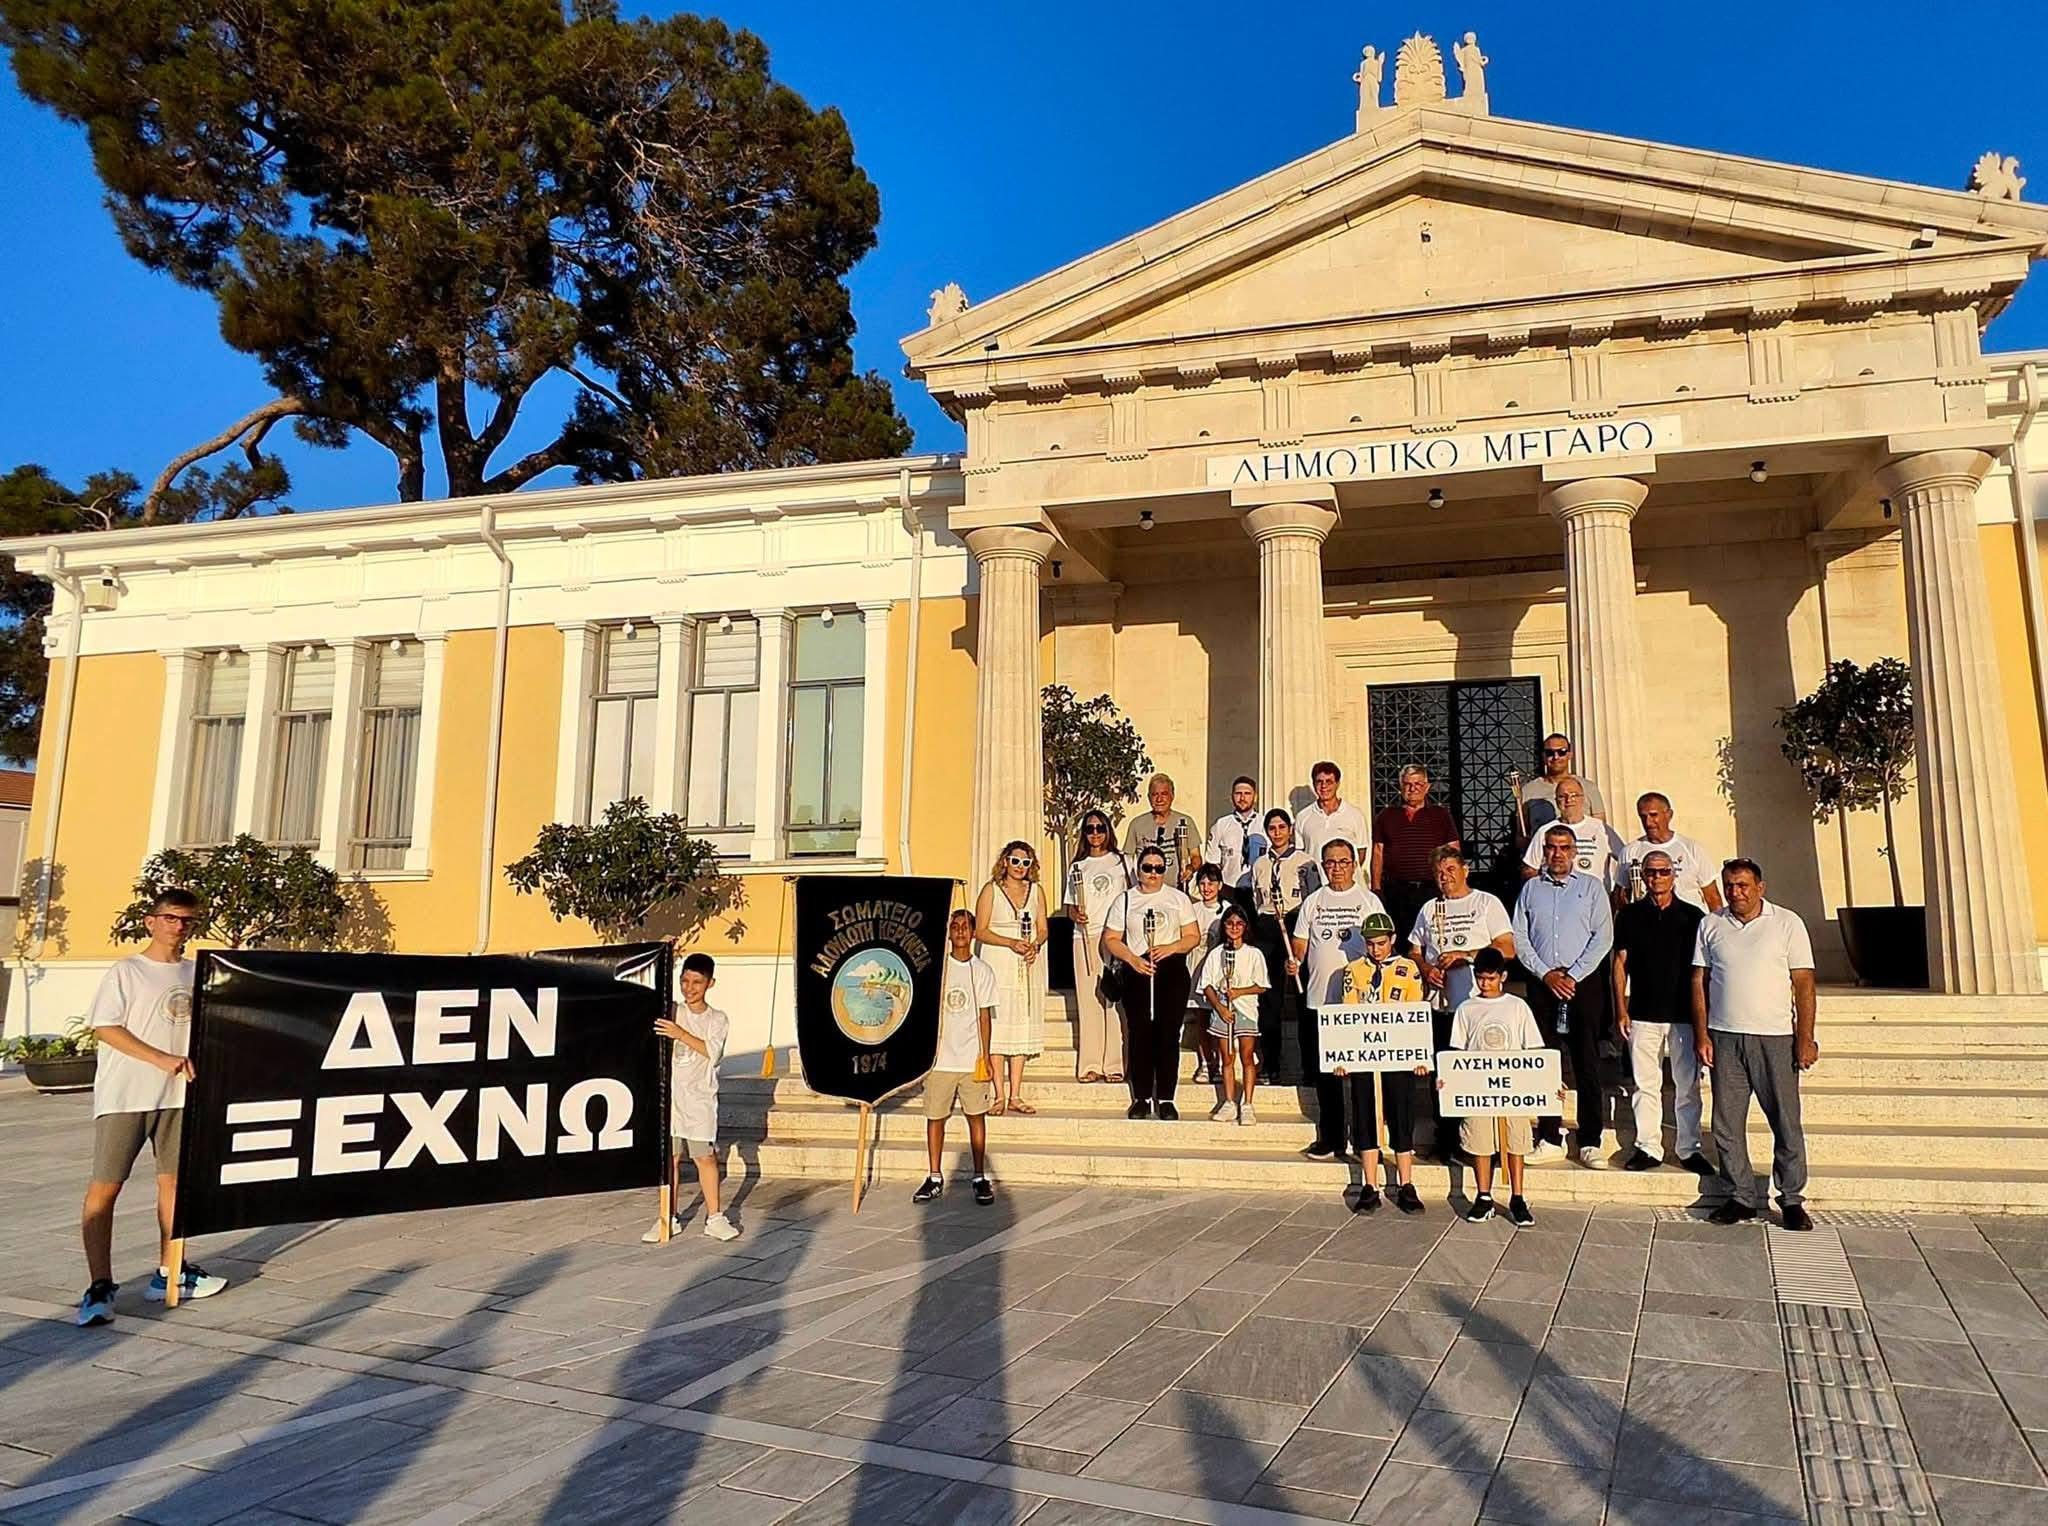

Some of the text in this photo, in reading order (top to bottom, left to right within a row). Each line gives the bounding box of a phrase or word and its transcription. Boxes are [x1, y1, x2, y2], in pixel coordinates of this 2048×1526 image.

[1484, 421, 1652, 463] ΜΕΓΑΡΟ
[827, 900, 924, 931] ΣΩΜΑΤΕΙΟ
[1321, 1011, 1430, 1026] Η ΚΕΡΥΝΕΙΑ ΖΕΙ
[321, 987, 558, 1069] ΔΕΝ
[1363, 1031, 1387, 1043] ΚΑΙ
[1326, 1049, 1428, 1062] ΜΑΣ ΚΑΡΤΕΡΕΙ
[1453, 1057, 1545, 1070] ΛΥΣΗ ΜΟΝΟ
[1488, 1077, 1511, 1089] ΜΕ
[1455, 1094, 1547, 1108] ΕΠΙΣΤΡΟΦΗ
[220, 1077, 634, 1185] ΞΕΧΝΩ
